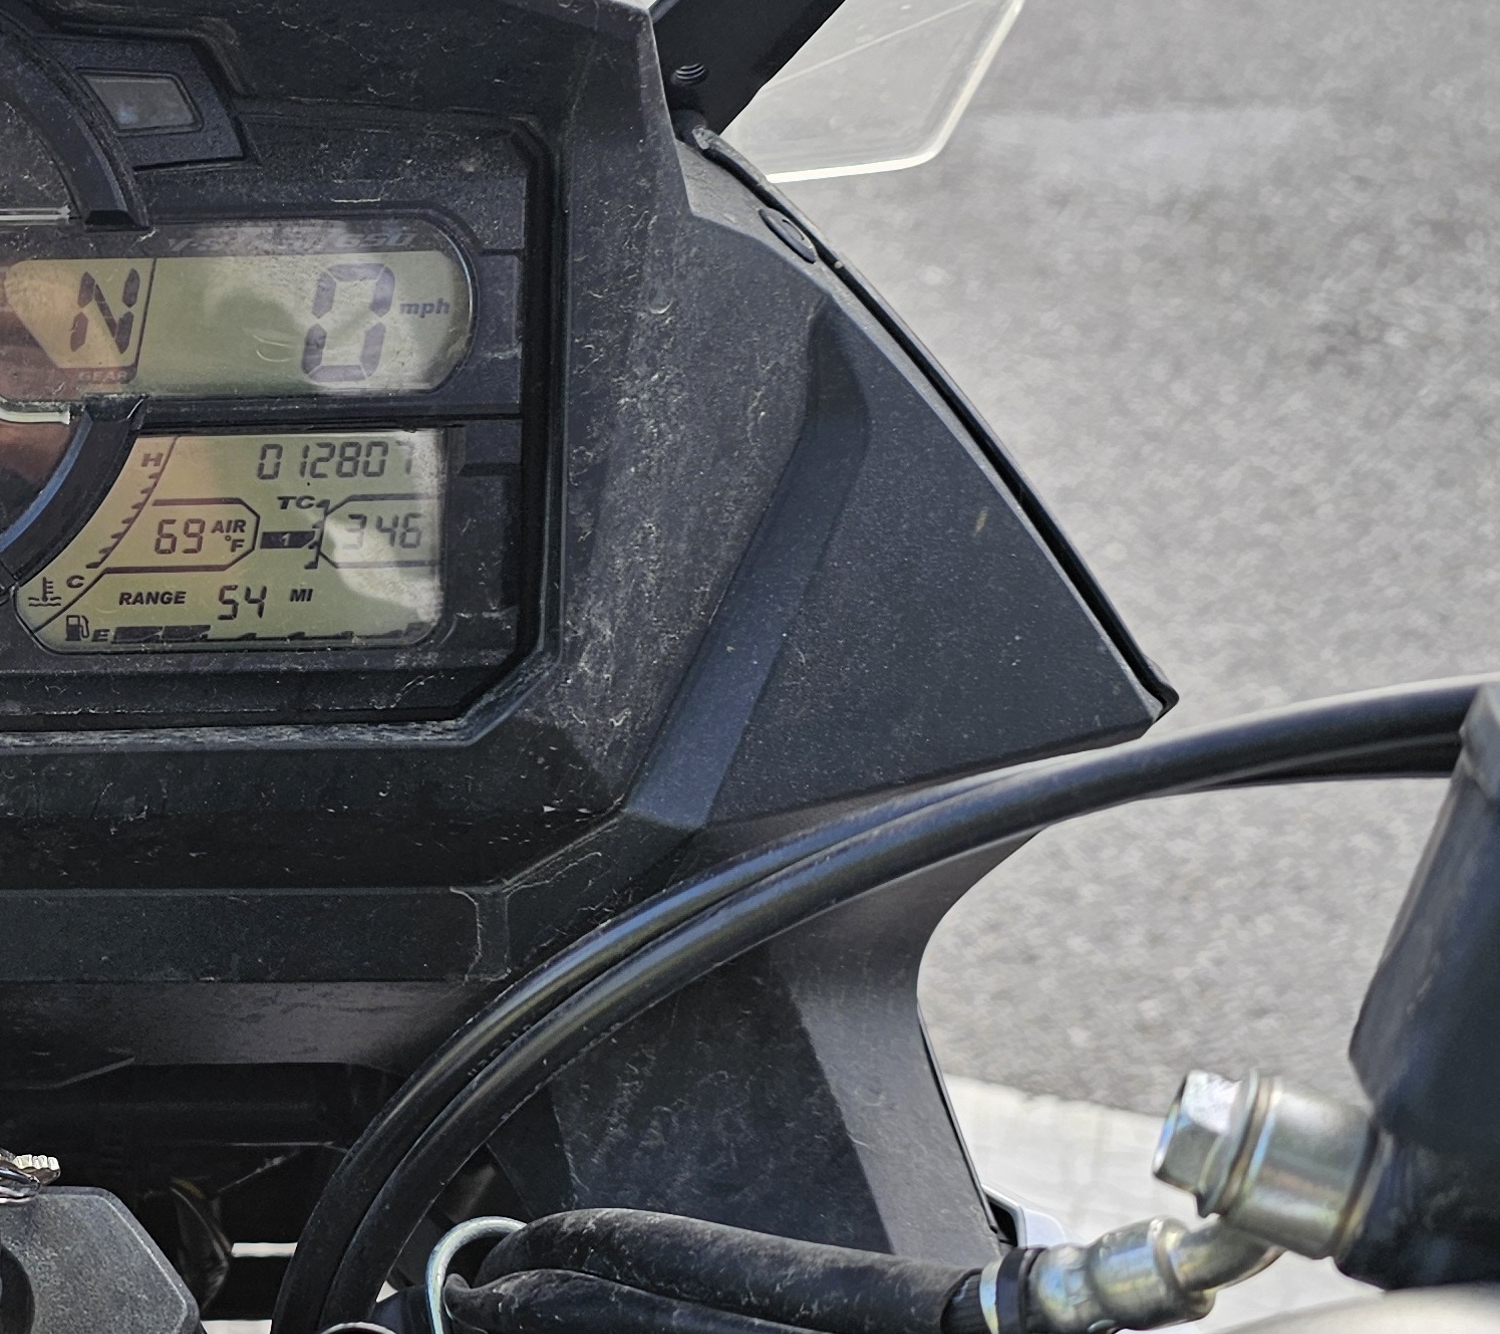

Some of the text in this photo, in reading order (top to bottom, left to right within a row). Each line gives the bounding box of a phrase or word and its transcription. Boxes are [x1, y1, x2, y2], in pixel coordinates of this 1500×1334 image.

[69, 267, 141, 355] N
[301, 262, 450, 384] 0 mph
[140, 452, 164, 467] H
[277, 495, 316, 510] TC
[154, 518, 247, 555] 69 AIR
[66, 575, 85, 589] C
[118, 584, 314, 621] RANGE 54 MI
[91, 628, 110, 643] E
